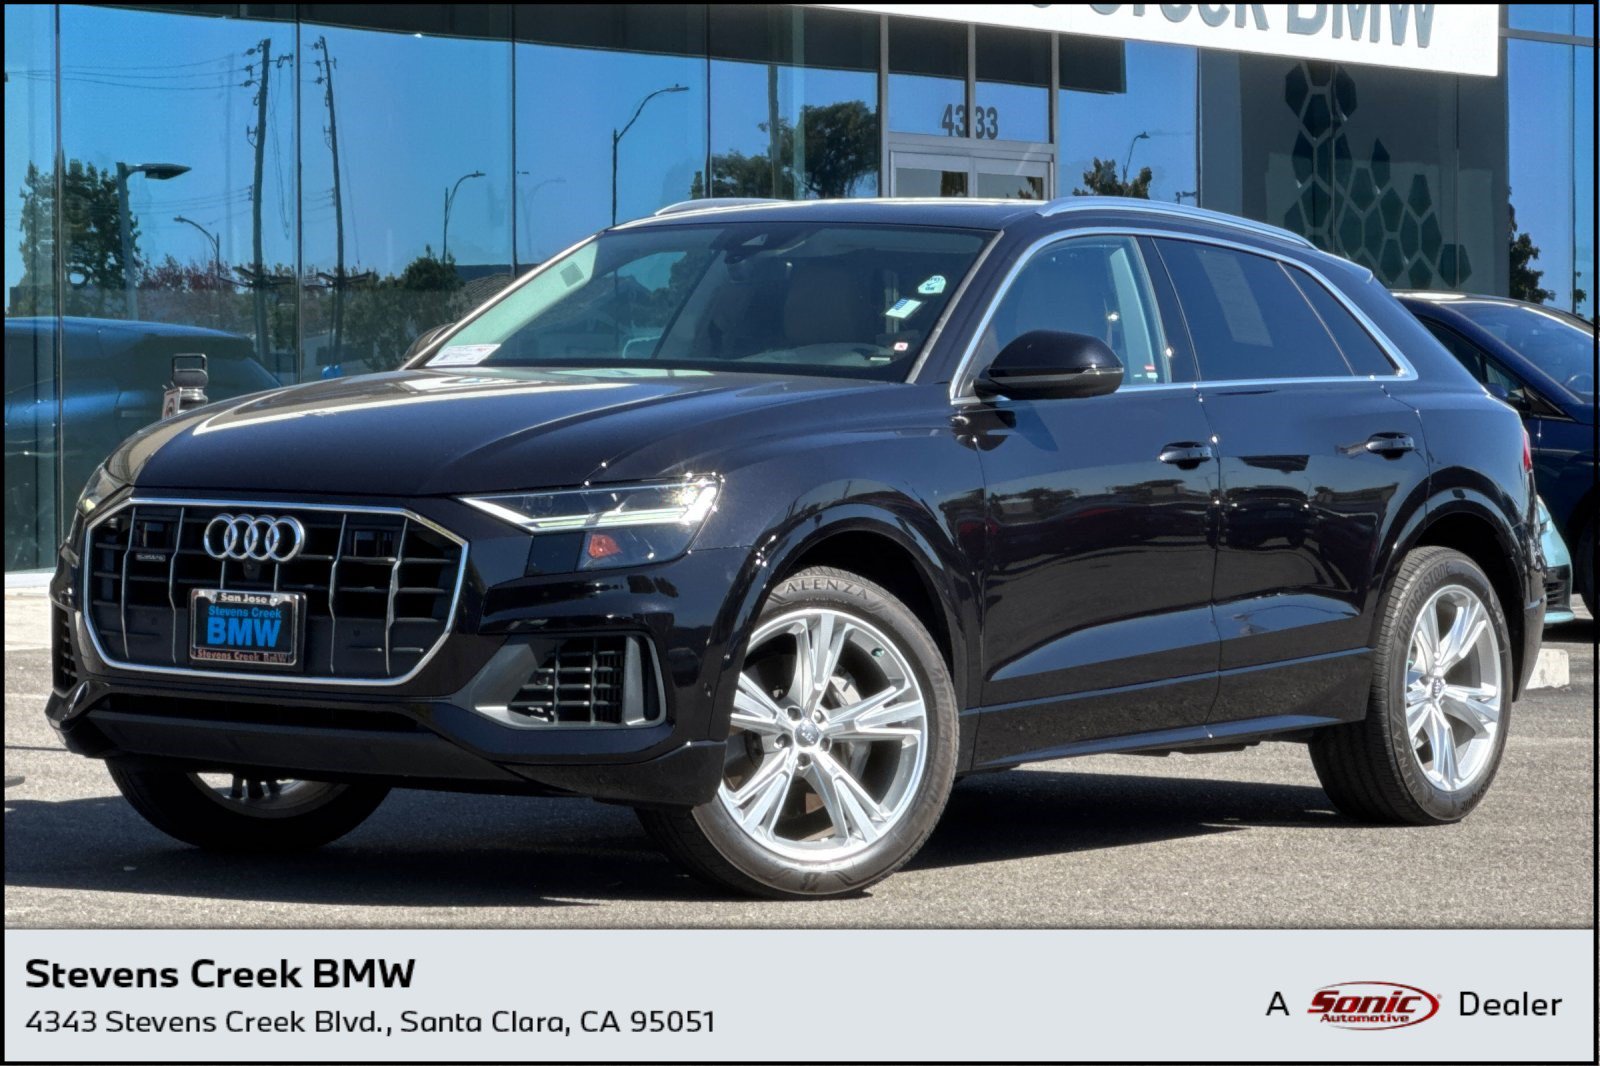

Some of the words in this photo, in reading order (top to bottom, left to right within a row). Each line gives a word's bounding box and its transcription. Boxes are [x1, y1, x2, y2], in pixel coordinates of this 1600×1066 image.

[785, 579, 868, 601] ALENZA
[221, 592, 241, 603] San
[244, 594, 268, 604] Jose
[208, 605, 249, 617] Stevens
[251, 607, 282, 619] Creek
[207, 616, 282, 648] BMW
[198, 649, 232, 660] Stevens
